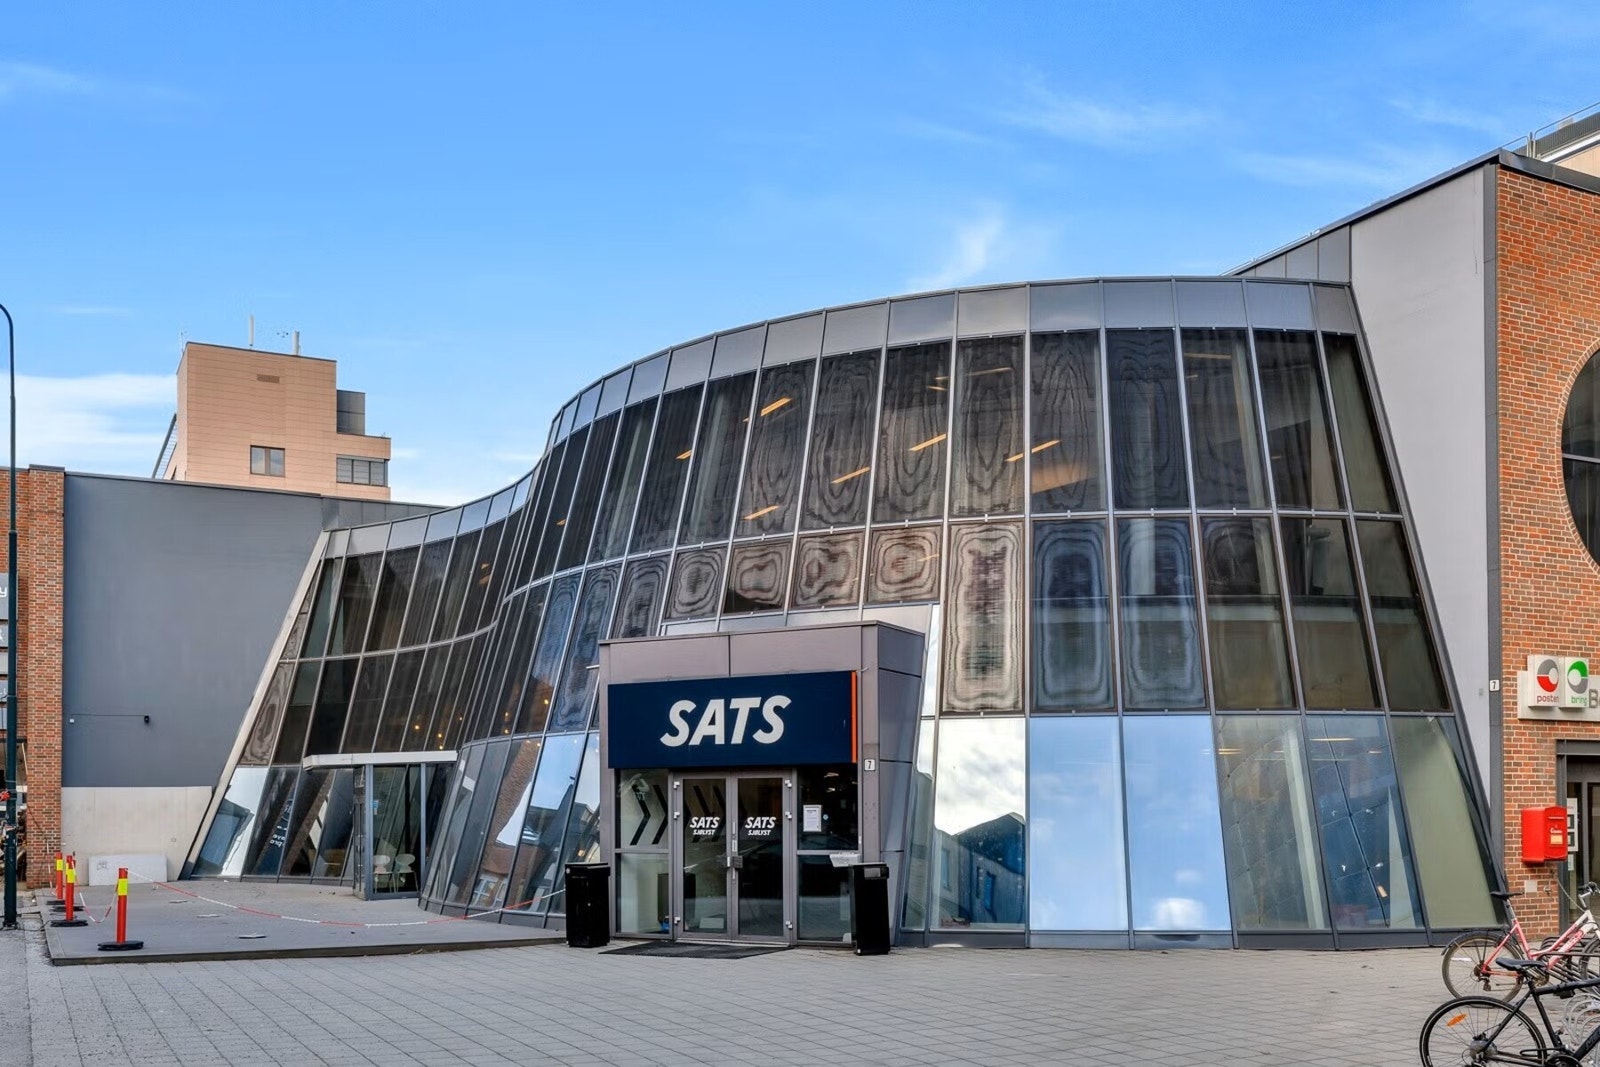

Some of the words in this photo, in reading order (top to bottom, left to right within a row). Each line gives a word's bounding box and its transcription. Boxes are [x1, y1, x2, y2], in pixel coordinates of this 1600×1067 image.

[1536, 694, 1560, 704] posten
[1571, 695, 1588, 706] bring
[659, 694, 792, 747] SATS
[689, 816, 720, 829] SATS
[744, 816, 777, 829] SATS
